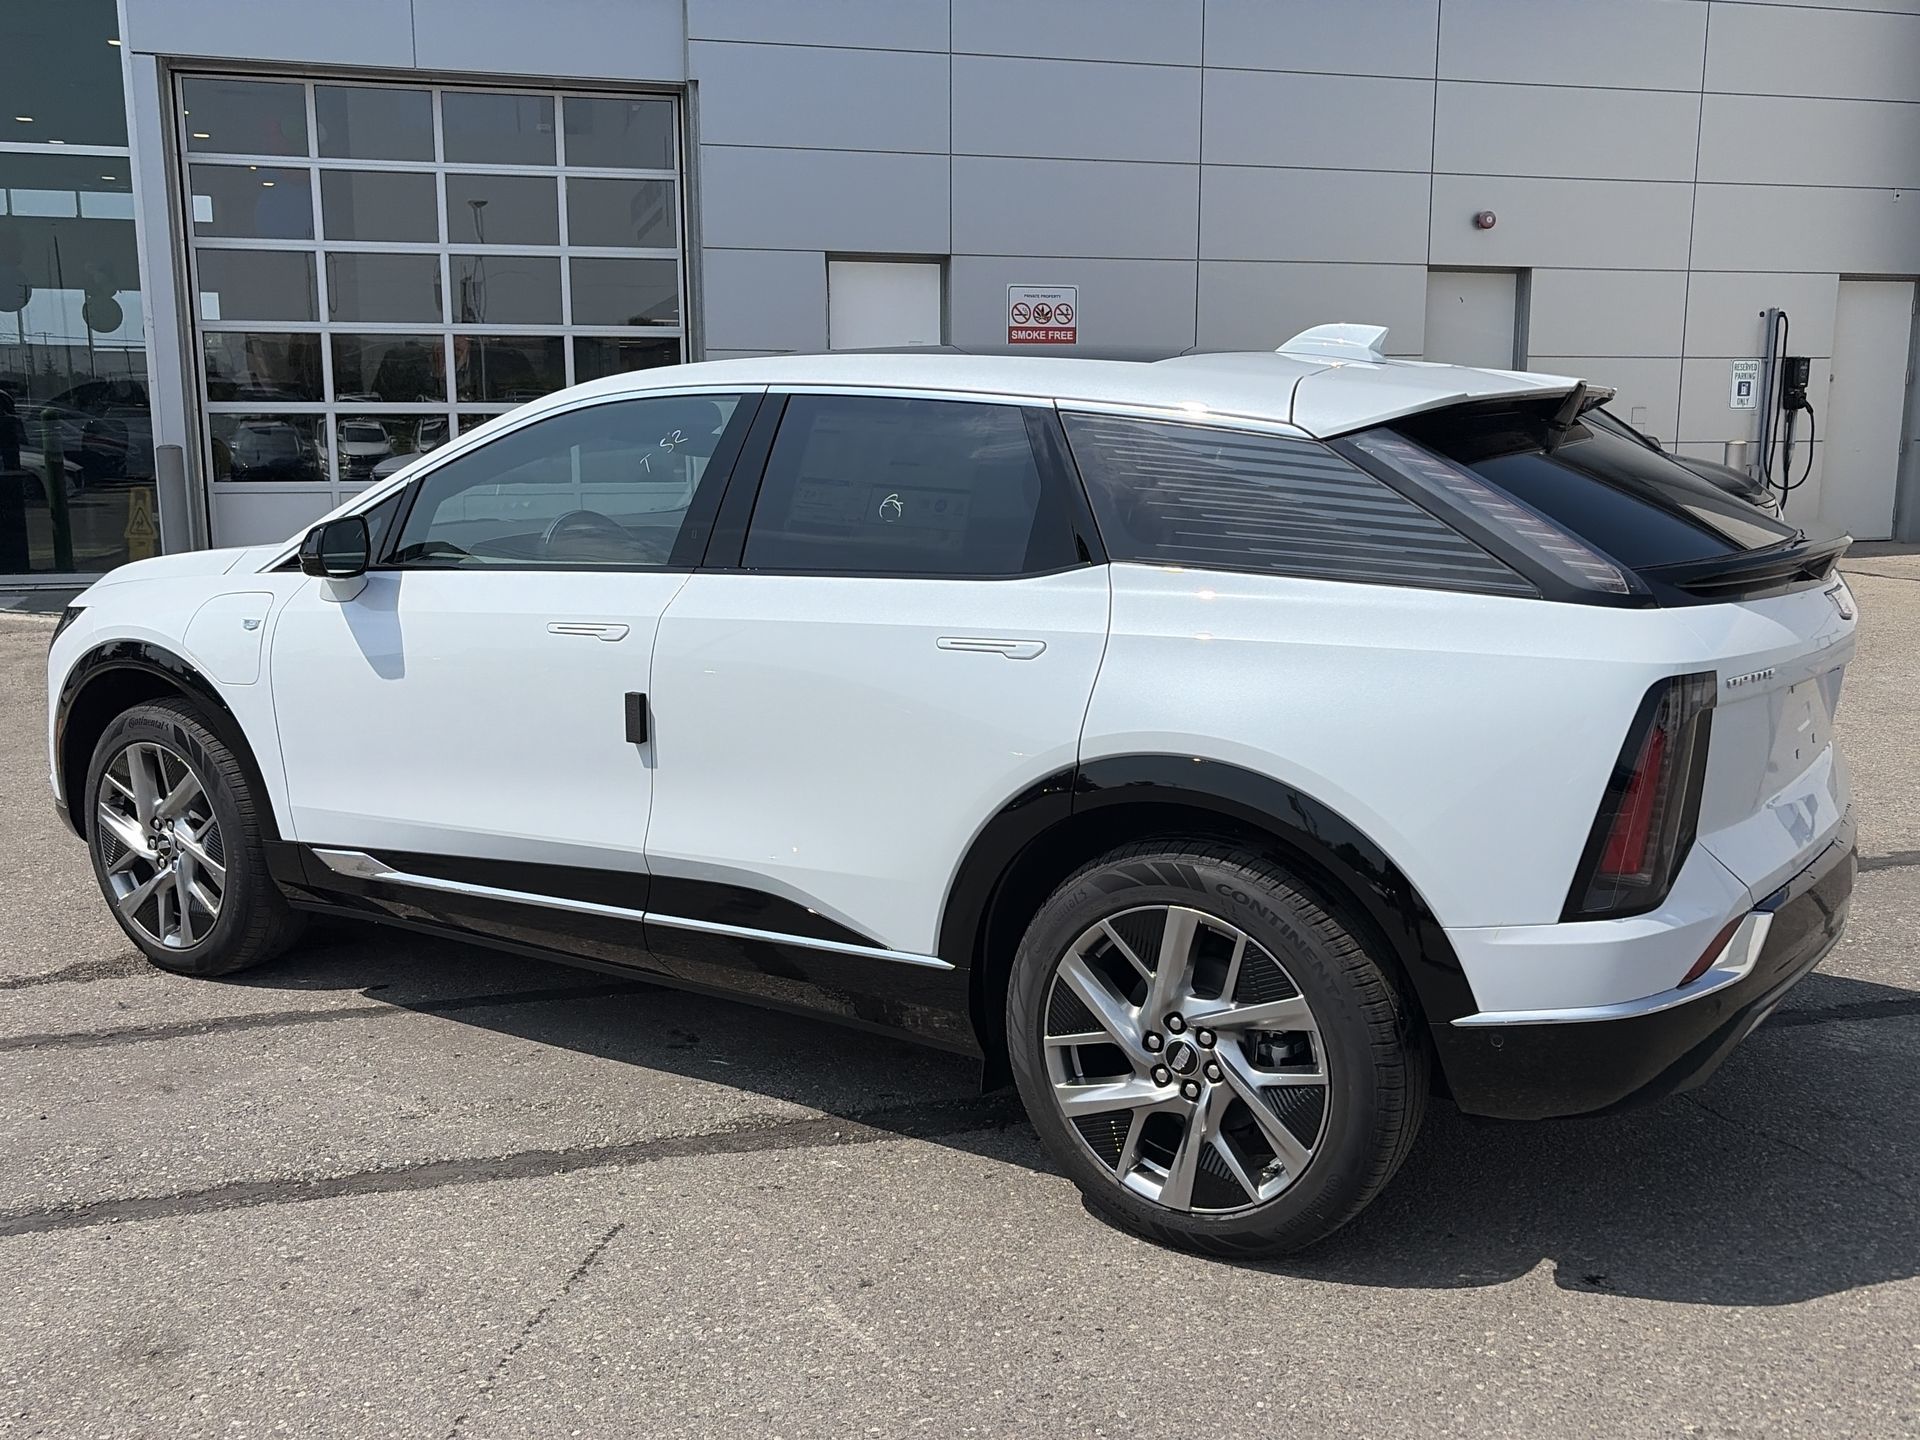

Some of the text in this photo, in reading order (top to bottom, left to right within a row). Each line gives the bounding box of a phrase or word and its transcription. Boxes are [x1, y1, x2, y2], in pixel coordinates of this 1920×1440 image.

[1011, 330, 1074, 340] SMOKE FREE
[1734, 363, 1758, 371] RESERVED
[1734, 372, 1756, 380] PARKING
[1736, 398, 1750, 406] ONLY
